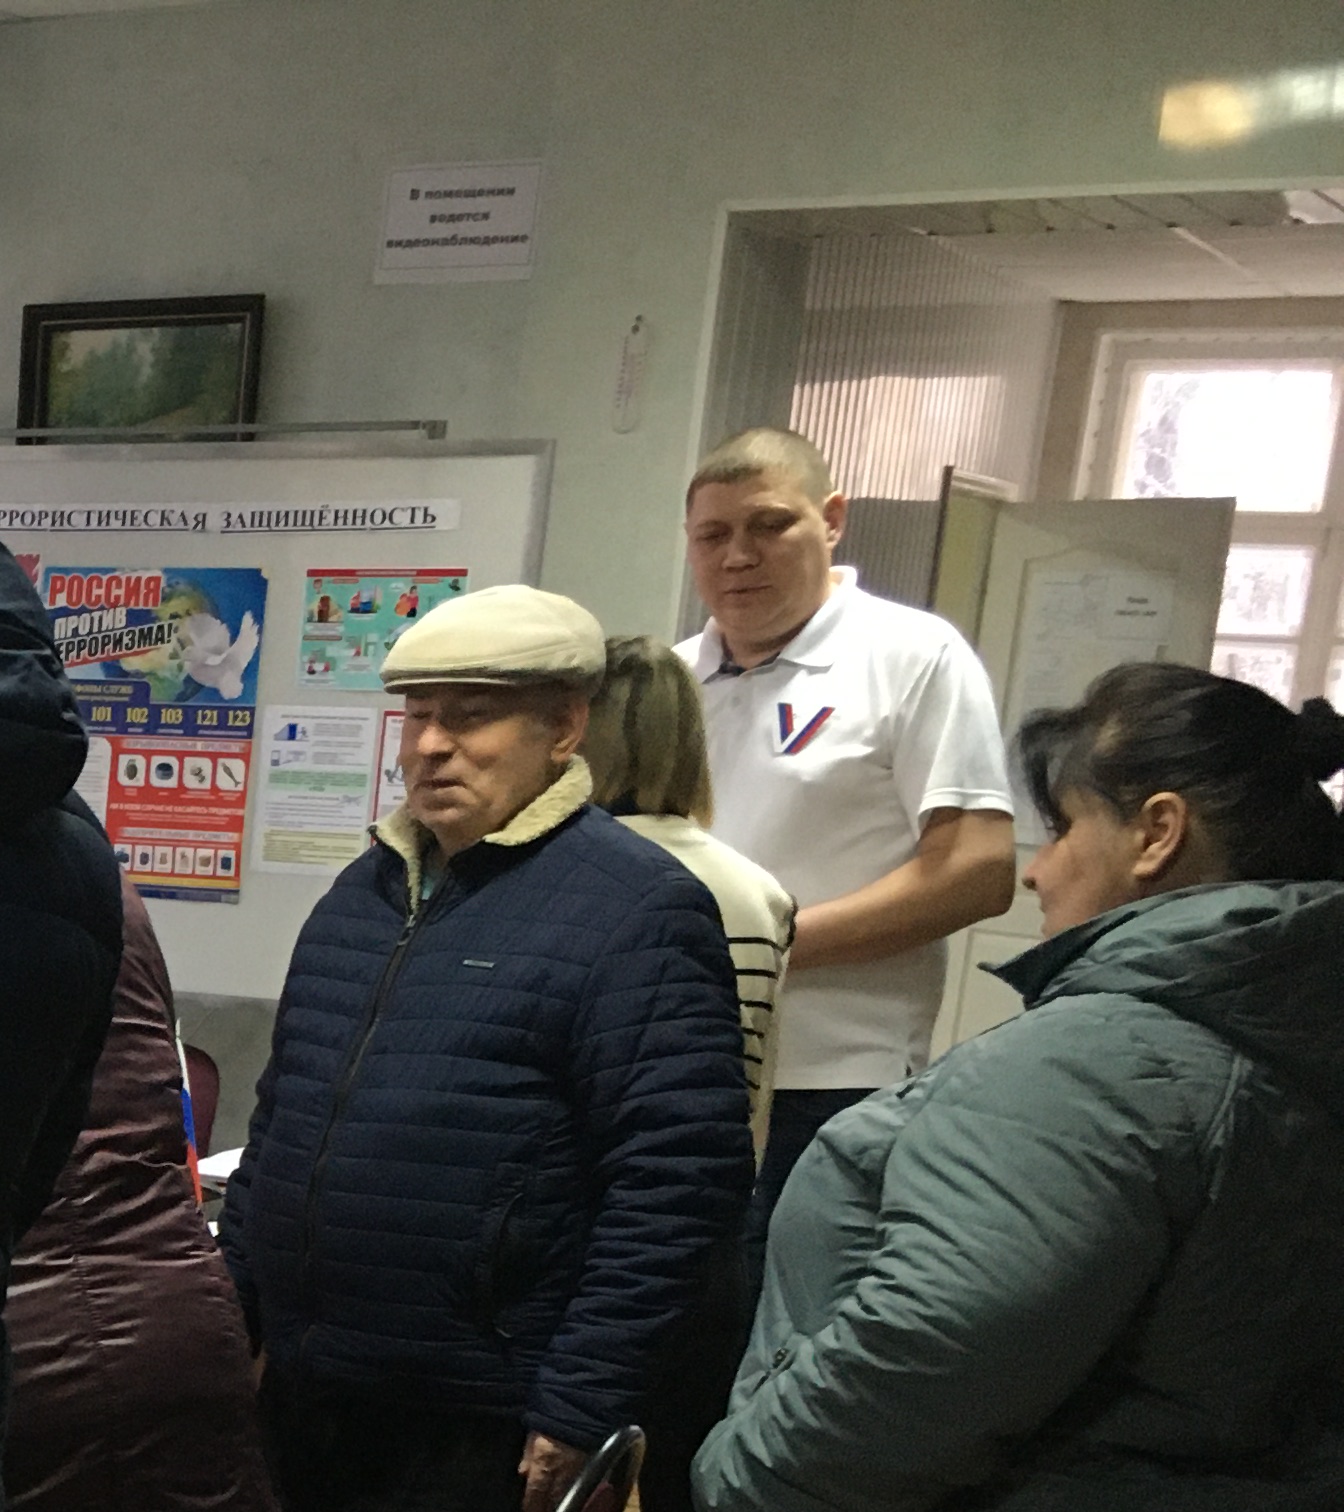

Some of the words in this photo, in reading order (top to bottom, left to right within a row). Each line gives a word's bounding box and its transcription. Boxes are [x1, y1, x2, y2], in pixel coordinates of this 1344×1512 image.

[409, 188, 420, 201] В
[424, 186, 516, 200] помещении
[385, 233, 530, 249] видеонаблюдение
[220, 503, 437, 530] ЗАЩИЩЁННОСТЬ
[47, 574, 163, 609] РОССИЯ
[53, 606, 128, 640] ПРОТИВ
[55, 621, 174, 662] ЕРРОРИЗМА!
[90, 705, 113, 723] 101
[125, 706, 149, 724] 102
[160, 707, 184, 725] 103
[195, 709, 219, 726] 121
[226, 710, 251, 727] 123
